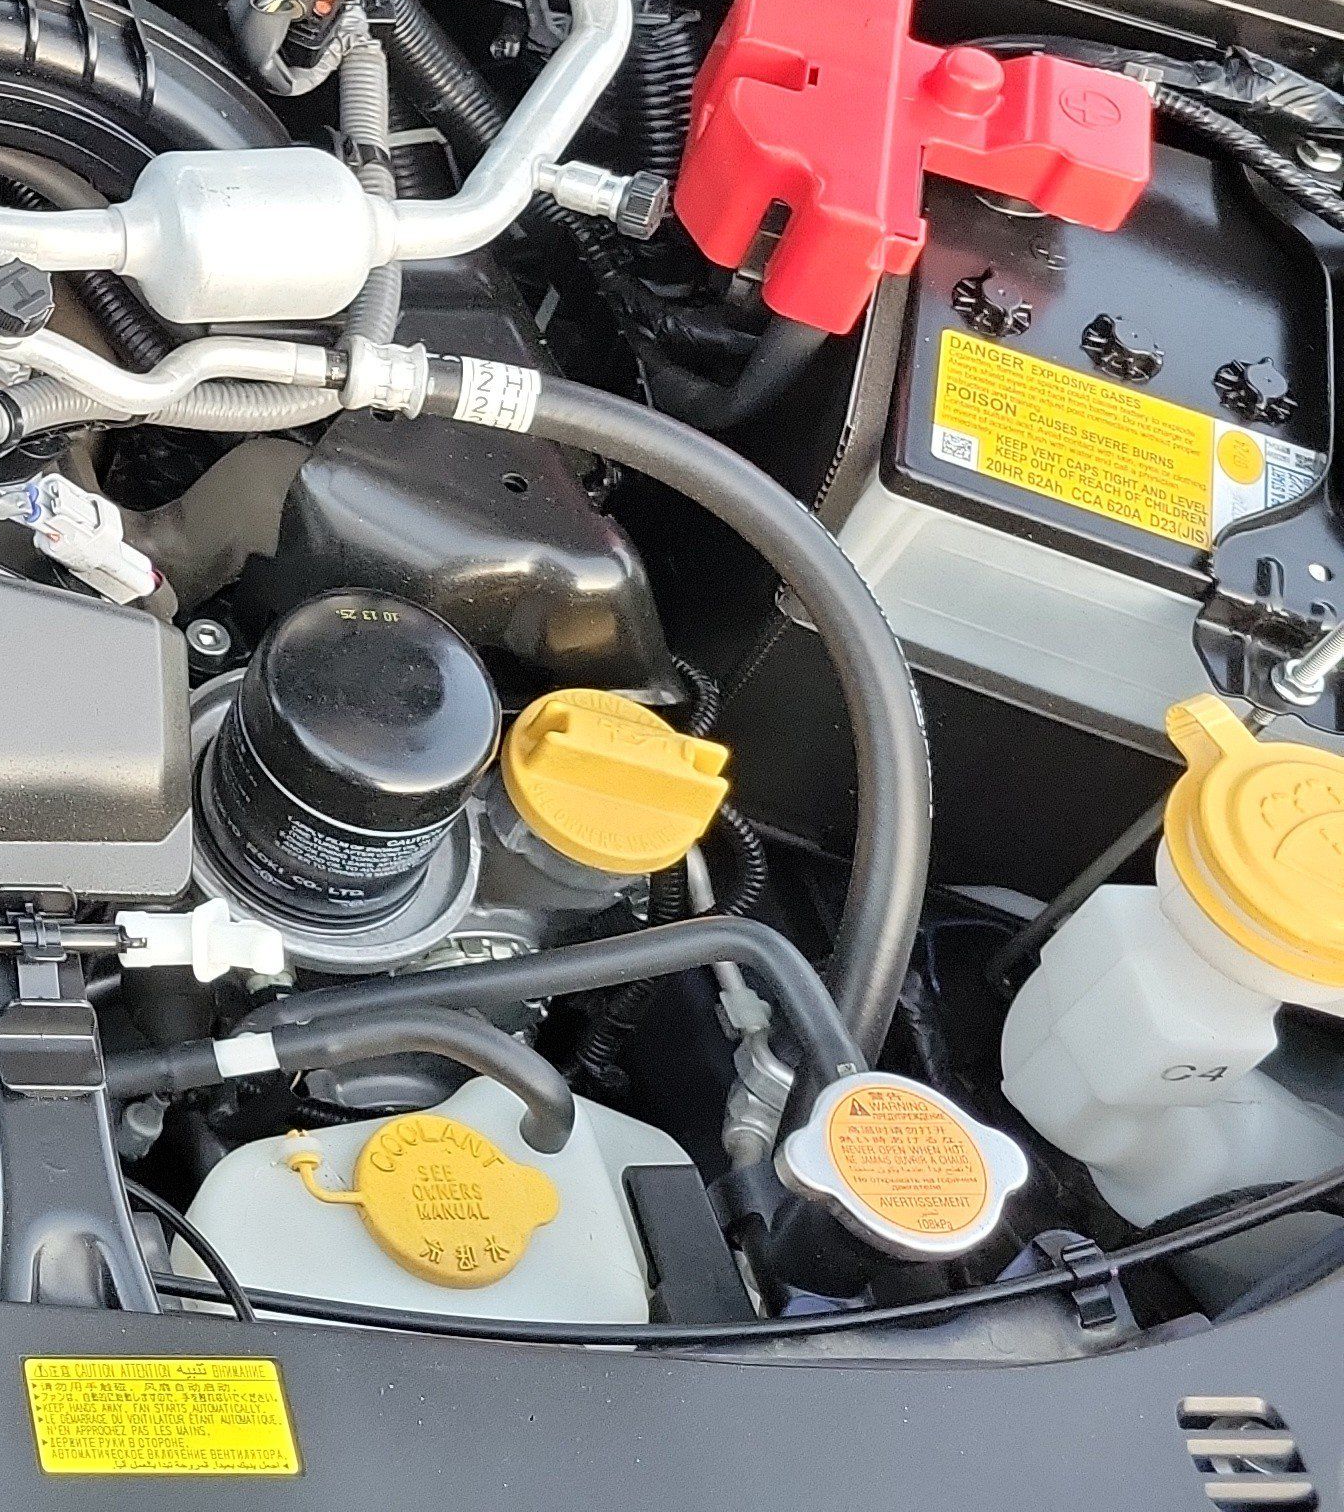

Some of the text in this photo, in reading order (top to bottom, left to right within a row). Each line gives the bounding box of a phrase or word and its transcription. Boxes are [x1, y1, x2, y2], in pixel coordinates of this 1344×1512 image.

[950, 335, 1141, 410] DANGER EXPLOSIVE GASES
[945, 381, 1173, 469] POISON CAUSES SEVERE BURNS
[995, 433, 1027, 453] KEEP
[1032, 445, 1061, 465] VENT
[1066, 457, 1099, 478] CAPS
[1101, 469, 1137, 491] TIGHT
[1140, 482, 1166, 501] AND
[1170, 492, 1208, 516] LEVEL
[995, 444, 1206, 527] KEEP OUT OF REACH OF CHILDREN
[985, 456, 1209, 548] 20HR 62Ah CCA 620A D23(JIS)
[361, 610, 378, 621] 13
[382, 611, 401, 623] 10
[1160, 1064, 1228, 1082] C4
[869, 1101, 929, 1112] WARNING
[370, 1119, 505, 1173] COOLANT
[841, 1145, 876, 1155] NEVER
[878, 1145, 907, 1155] OPEN
[909, 1145, 941, 1155] WHEN
[417, 1164, 457, 1183] SEE
[411, 1182, 484, 1202] OWNERS
[879, 1196, 971, 1208] AVERTISSEMENT
[415, 1202, 491, 1221] MANUAL
[916, 1219, 954, 1231] 108kPa
[74, 1364, 115, 1378] CAUTION
[120, 1364, 171, 1378] ATTENTION
[42, 1403, 64, 1413] KEEP
[69, 1403, 97, 1413] HANDS
[133, 1404, 150, 1413] FAN
[154, 1404, 188, 1413] STARTS
[44, 1414, 55, 1424] LE
[111, 1414, 123, 1425] DU
[127, 1414, 184, 1425] VENTILATEUR
[75, 1425, 127, 1436] APPROCHEZ
[131, 1425, 149, 1436] PAS
[153, 1425, 172, 1436] LES
[98, 1437, 126, 1448] РУКИ
[51, 1449, 145, 1460] АВТОМАТИЧЕСКОЕ
